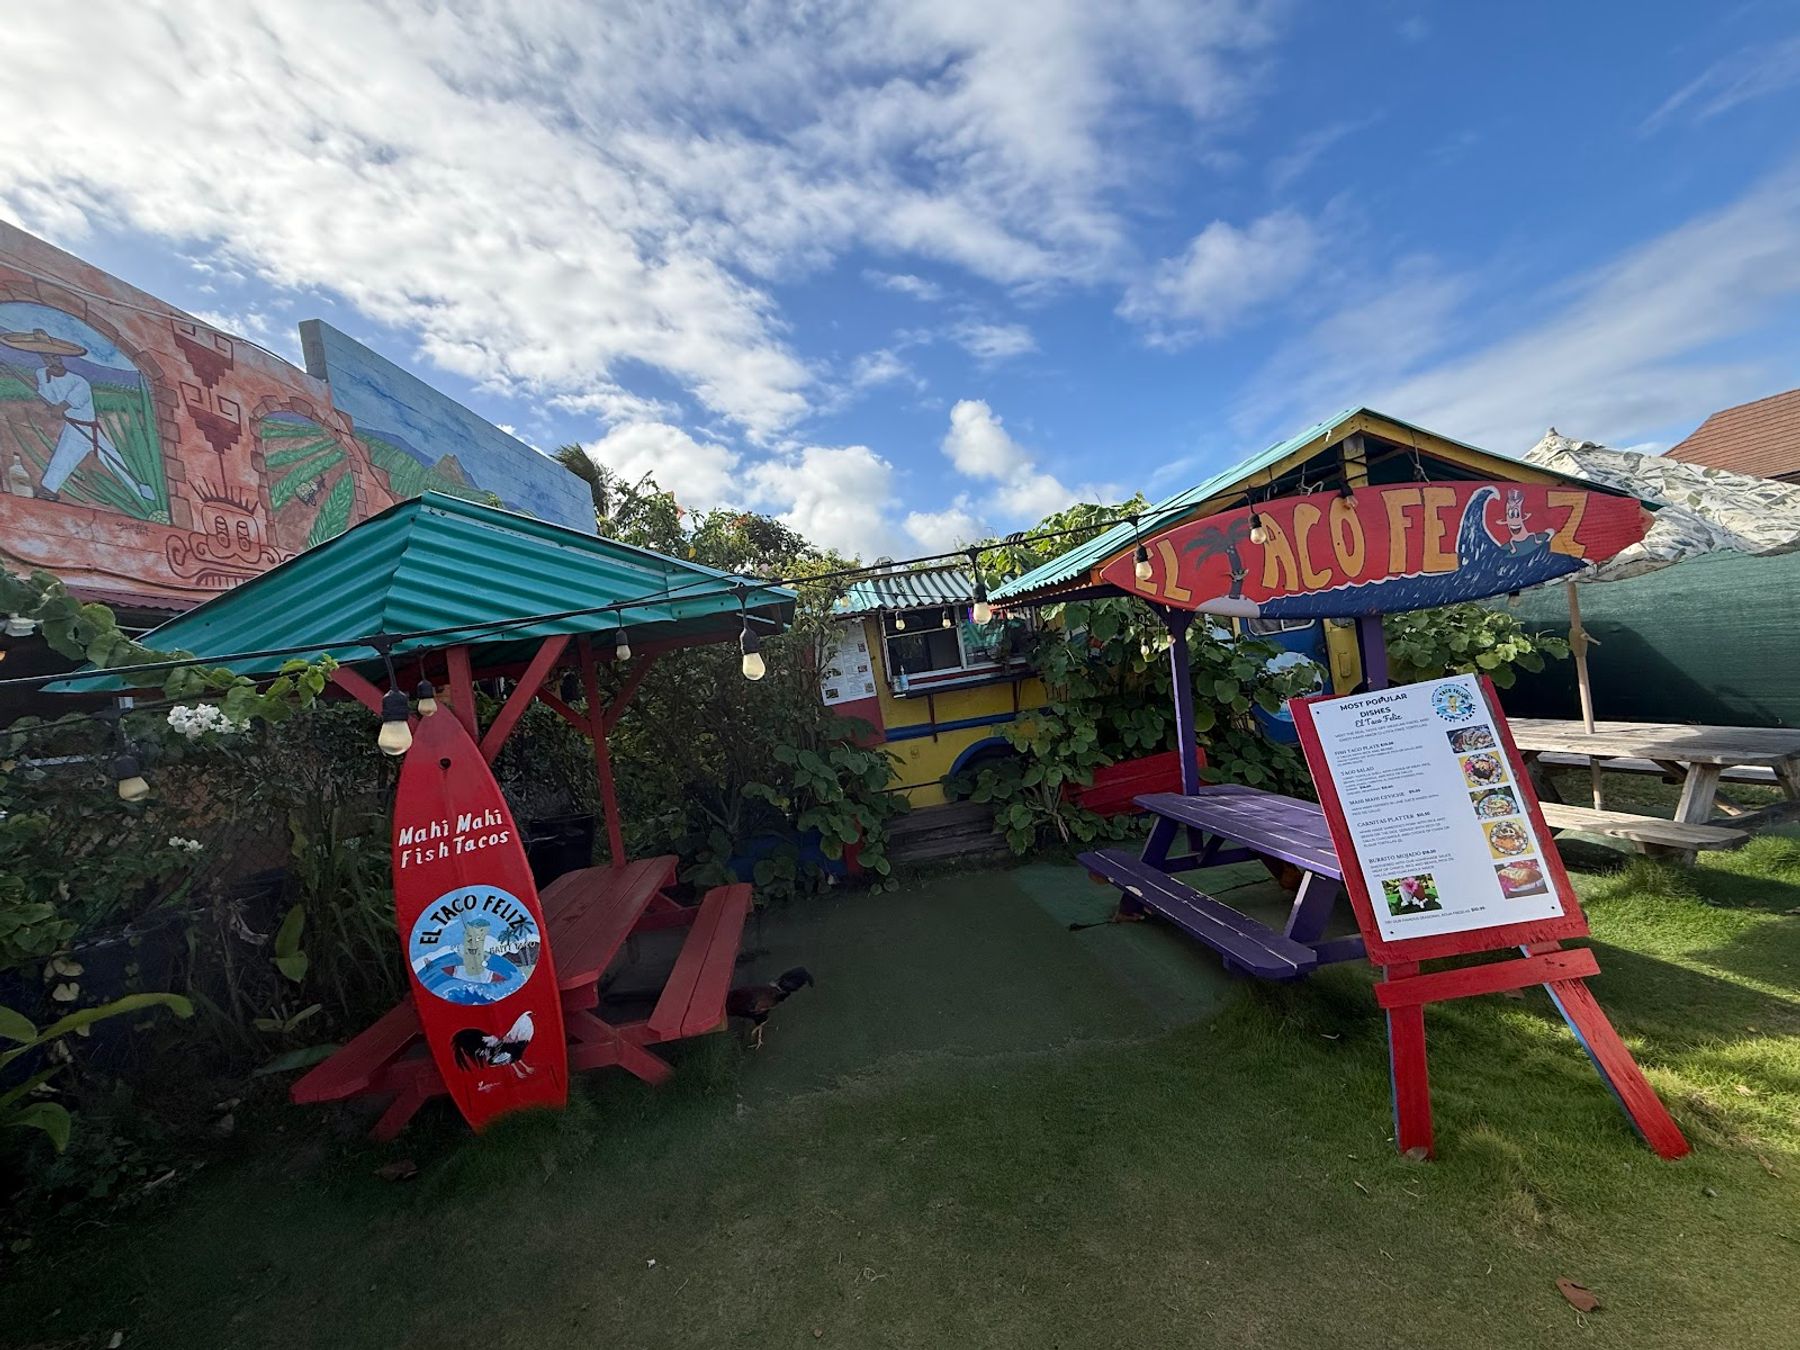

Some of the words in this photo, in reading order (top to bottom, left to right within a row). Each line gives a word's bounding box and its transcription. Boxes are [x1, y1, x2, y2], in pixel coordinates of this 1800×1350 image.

[1339, 701, 1364, 710] MOST
[1364, 693, 1407, 706] POPULAR
[1359, 706, 1391, 717] DISHES
[398, 820, 449, 846] Mahi
[456, 809, 503, 834] Mahi
[1356, 818, 1387, 827] CARNITAS
[1387, 813, 1414, 822] PLATTER
[401, 842, 449, 868] Fish
[453, 831, 510, 854] Tacos
[1368, 855, 1395, 863] BURRITO
[1396, 851, 1421, 859] MOJADO
[430, 894, 477, 926] TACO
[482, 895, 527, 930] FELIZ
[419, 928, 442, 945] EL
